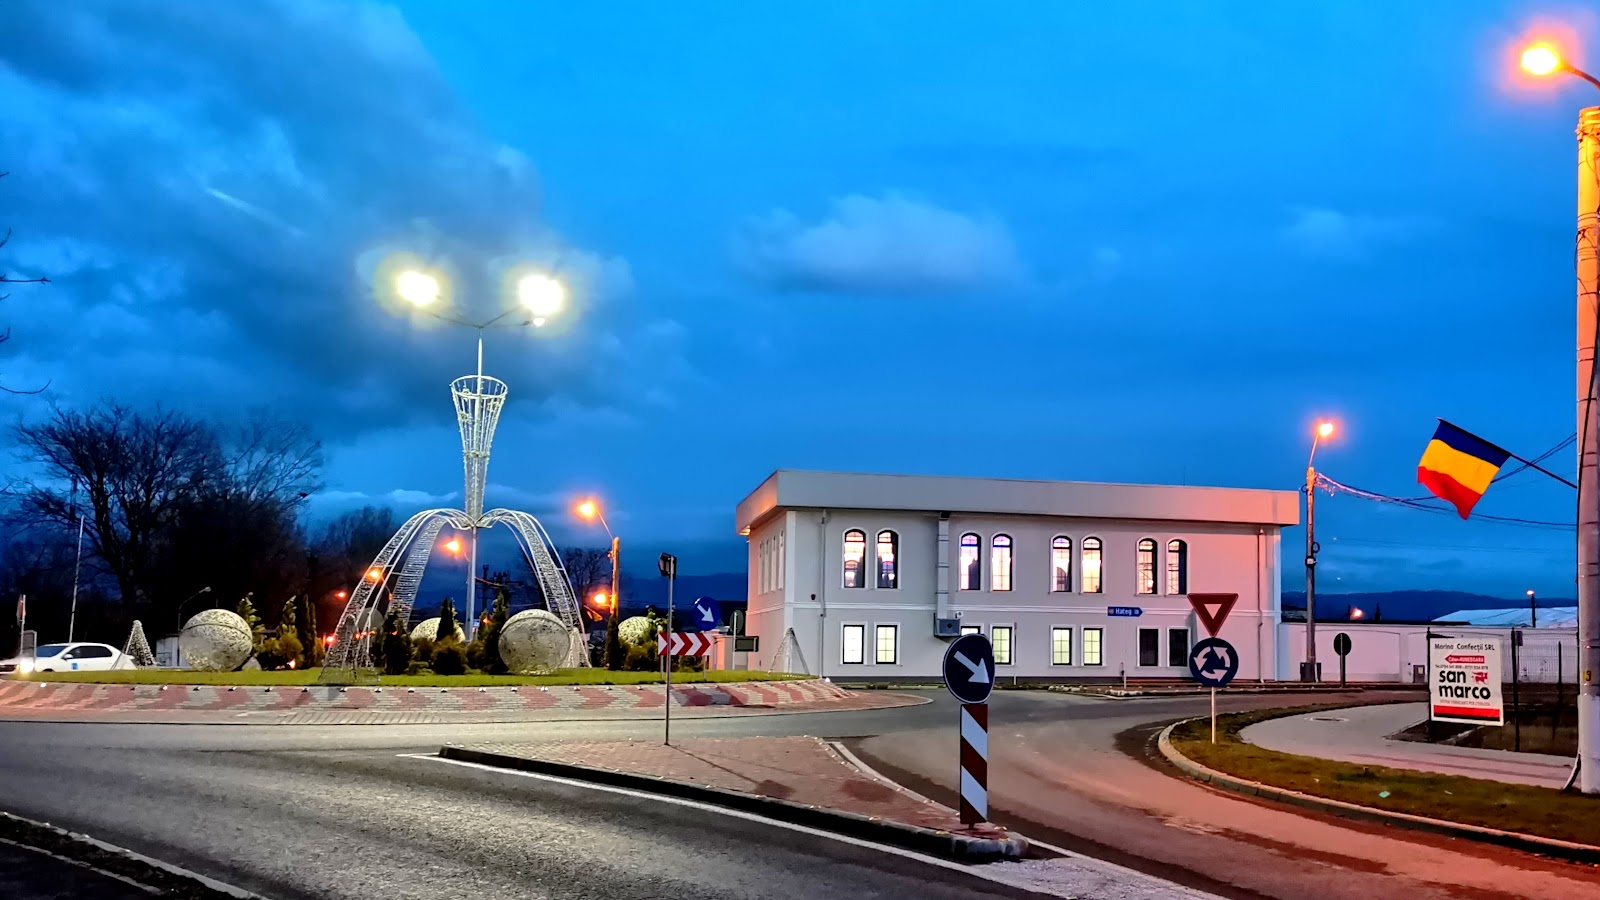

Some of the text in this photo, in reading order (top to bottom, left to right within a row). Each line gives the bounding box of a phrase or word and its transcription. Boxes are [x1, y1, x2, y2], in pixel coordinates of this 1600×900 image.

[1484, 643, 1495, 651] SRL
[1439, 670, 1466, 683] san
[1439, 685, 1491, 699] marco
